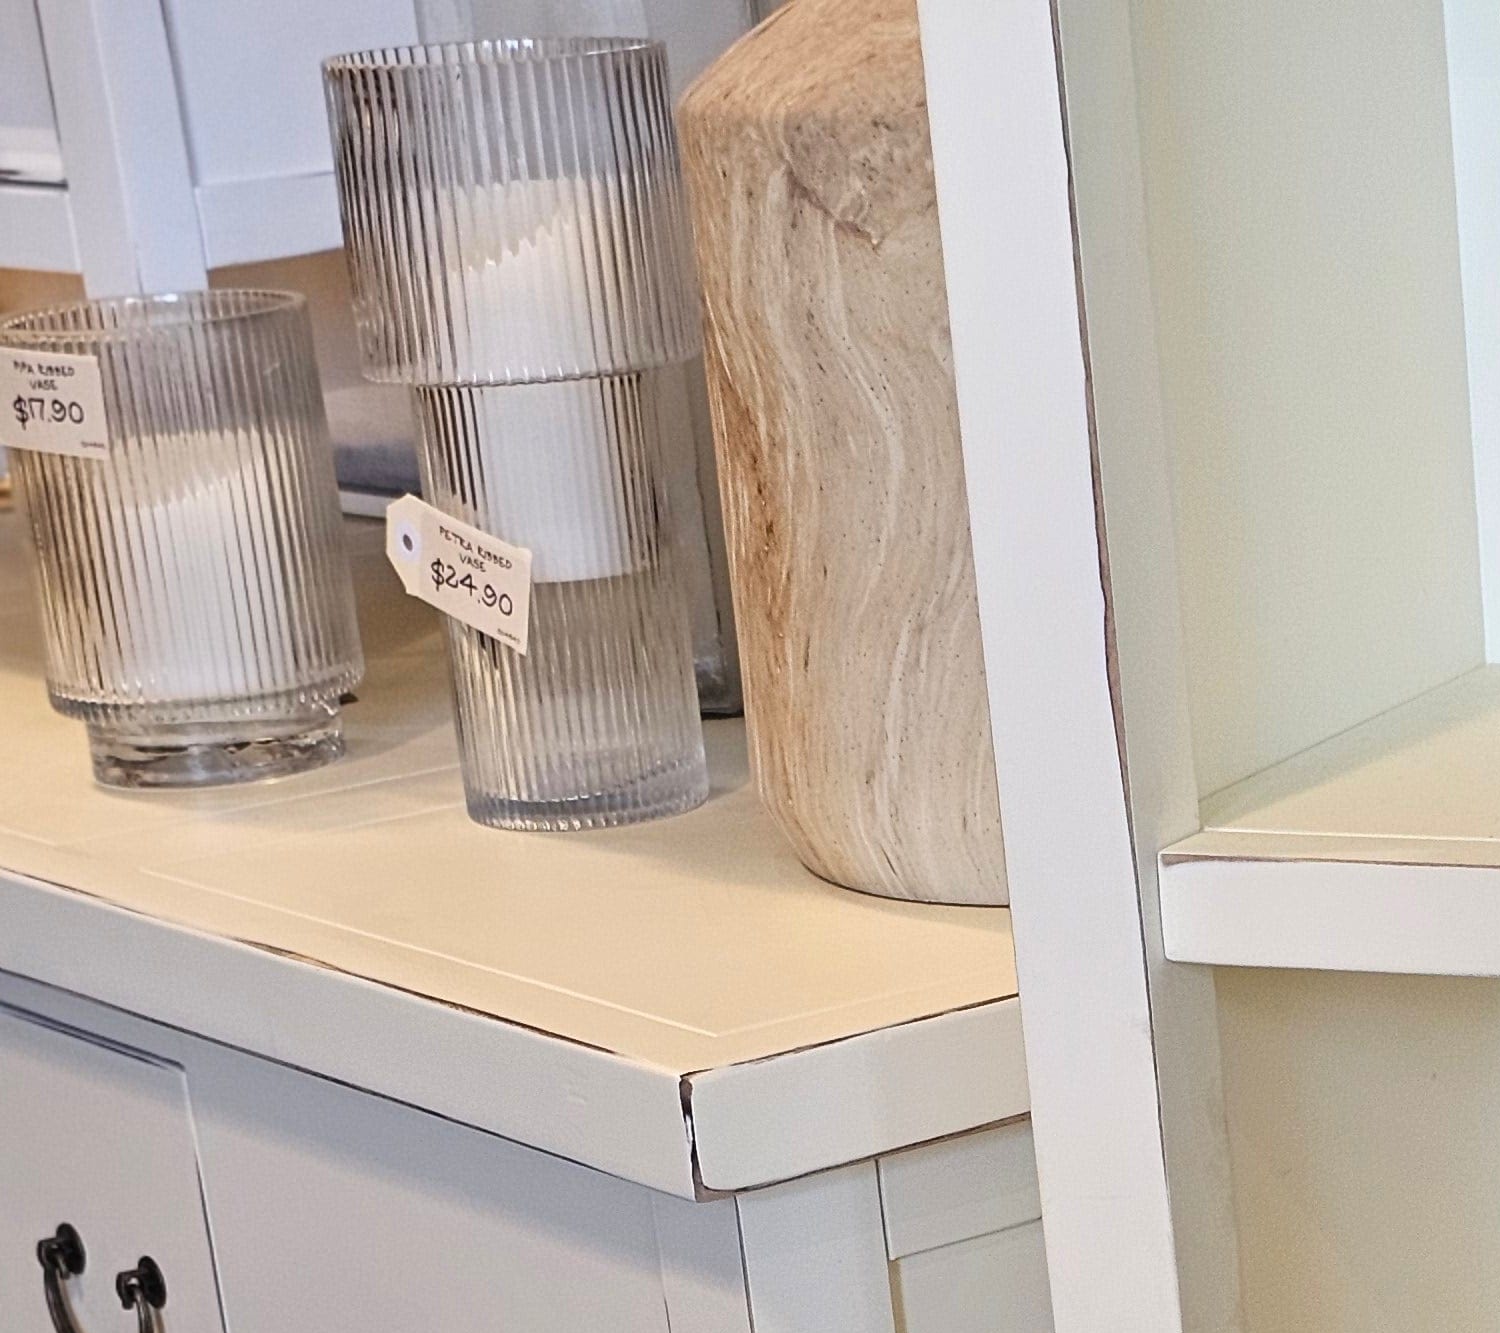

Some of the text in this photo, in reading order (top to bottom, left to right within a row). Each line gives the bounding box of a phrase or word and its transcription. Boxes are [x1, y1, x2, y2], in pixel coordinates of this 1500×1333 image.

[29, 379, 58, 391] VASE
[13, 394, 84, 431] $17.90
[439, 525, 513, 570] PETRA RIBBED
[459, 553, 486, 573] VASE
[430, 558, 514, 617] $24.90
